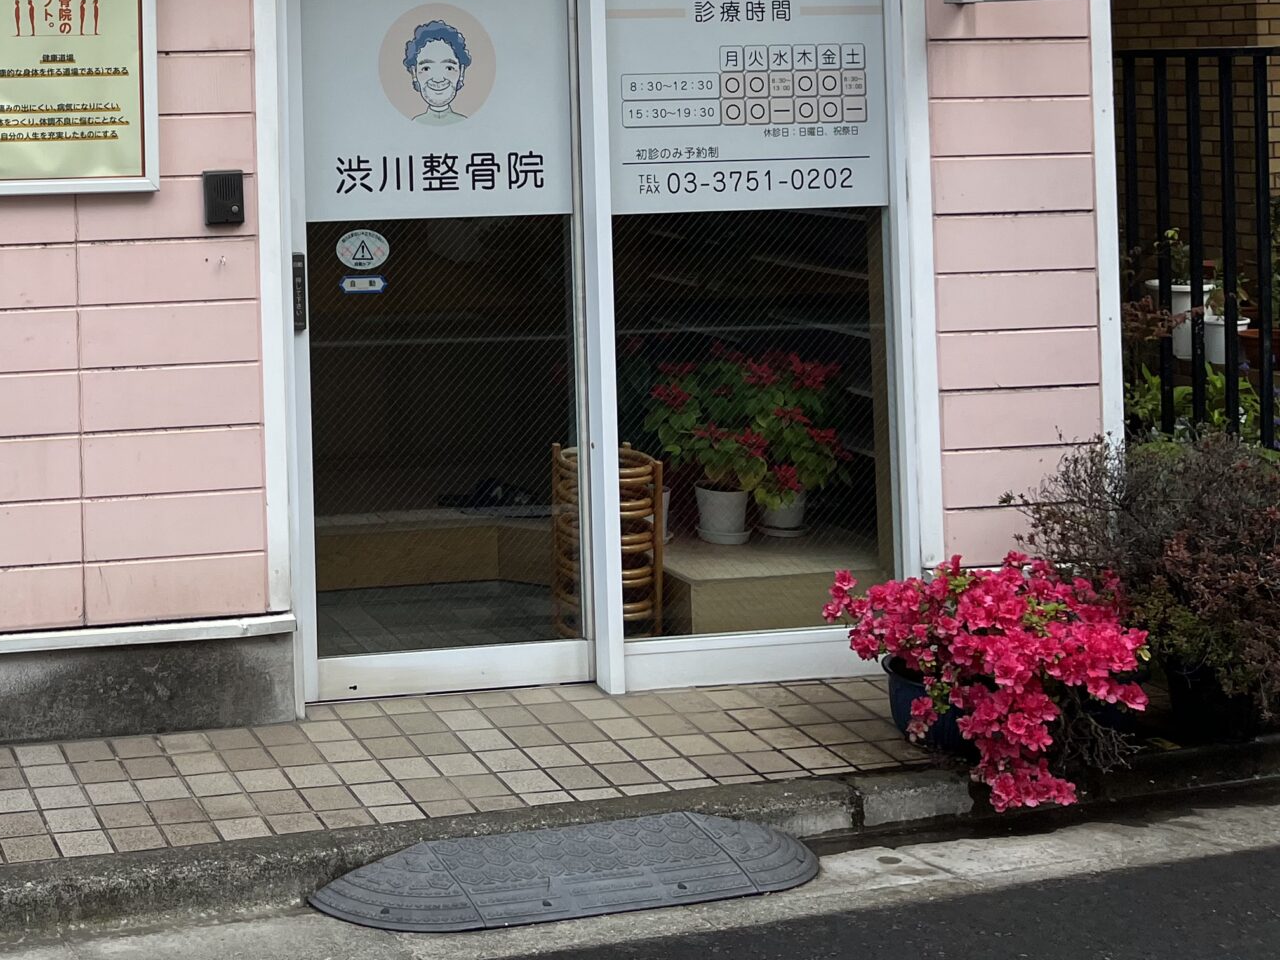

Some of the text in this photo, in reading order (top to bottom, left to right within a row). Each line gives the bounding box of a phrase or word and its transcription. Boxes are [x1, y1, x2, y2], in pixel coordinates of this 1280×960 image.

[694, 0, 792, 24] 診療時間
[42, 54, 74, 63] 健康道場
[724, 47, 861, 68] 月 火 水 木 金 土
[635, 146, 720, 161] 初診のみ予約制
[335, 150, 545, 194] 渋川整骨院
[638, 174, 660, 184] TEL
[666, 167, 854, 194] 03-3751-0202
[639, 184, 661, 195] FAX
